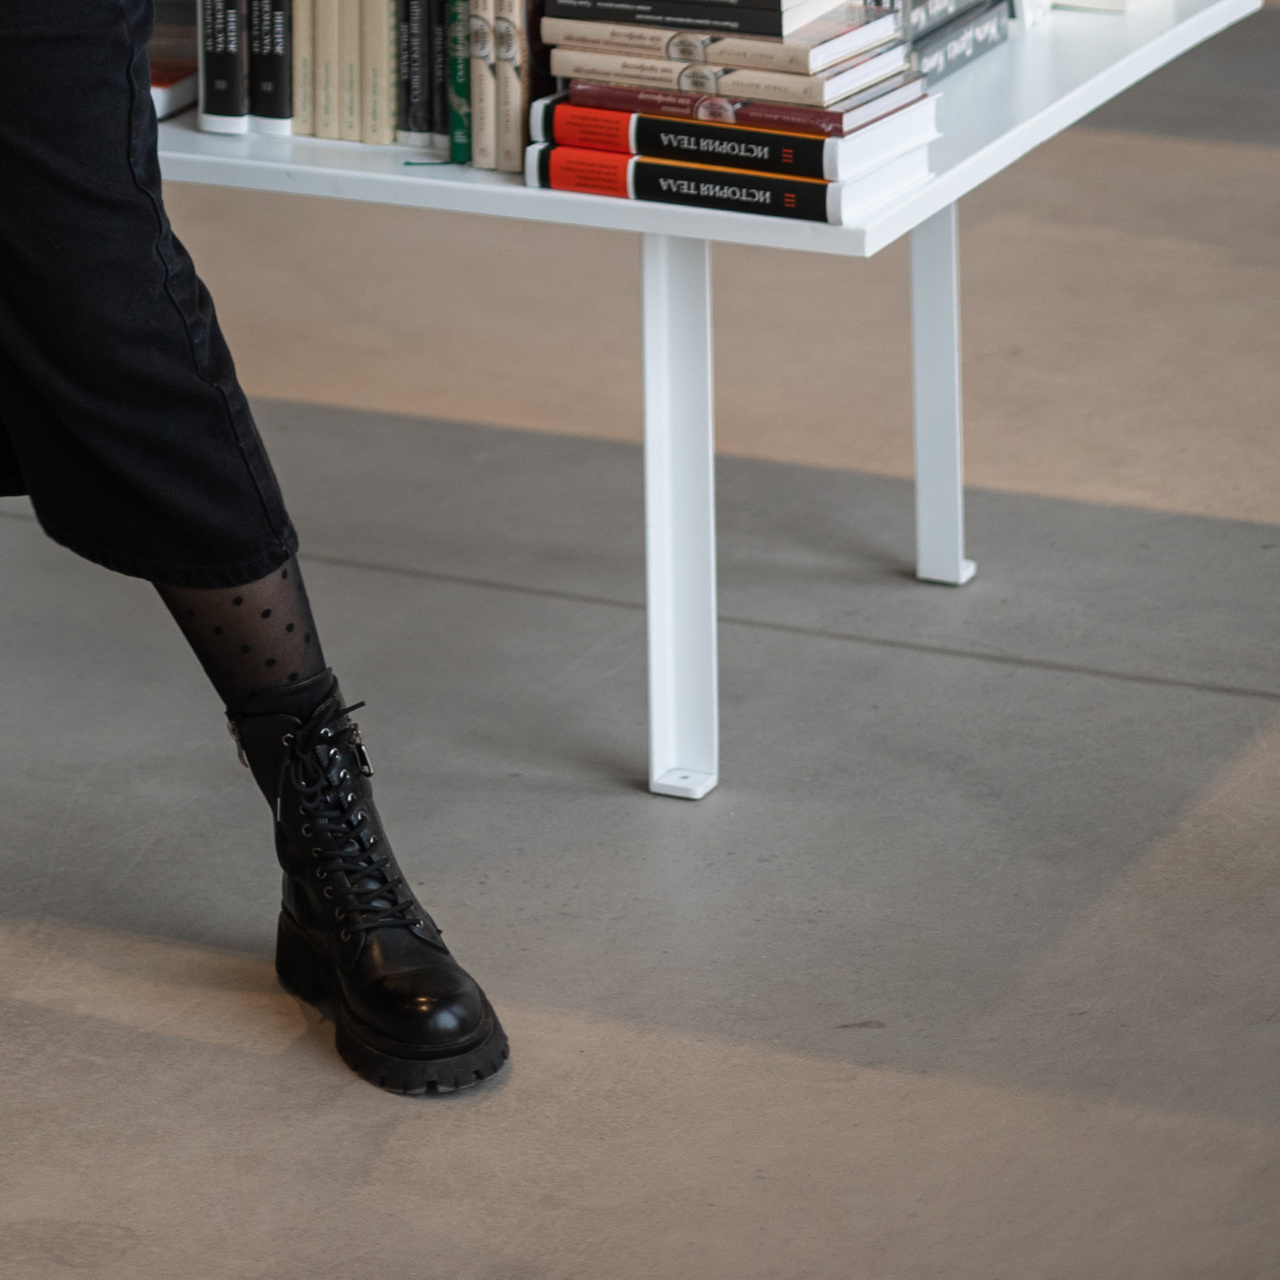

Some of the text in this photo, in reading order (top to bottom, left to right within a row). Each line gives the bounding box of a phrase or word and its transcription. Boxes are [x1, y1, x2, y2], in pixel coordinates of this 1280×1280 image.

[226, 9, 239, 55] ЖИЗНИ
[273, 11, 285, 57] ЖИЗНИ
[660, 133, 770, 159] ИСТОРИЯ ТЕЛА
[659, 178, 772, 204] ИСТОРИЯ ТЕЛА
